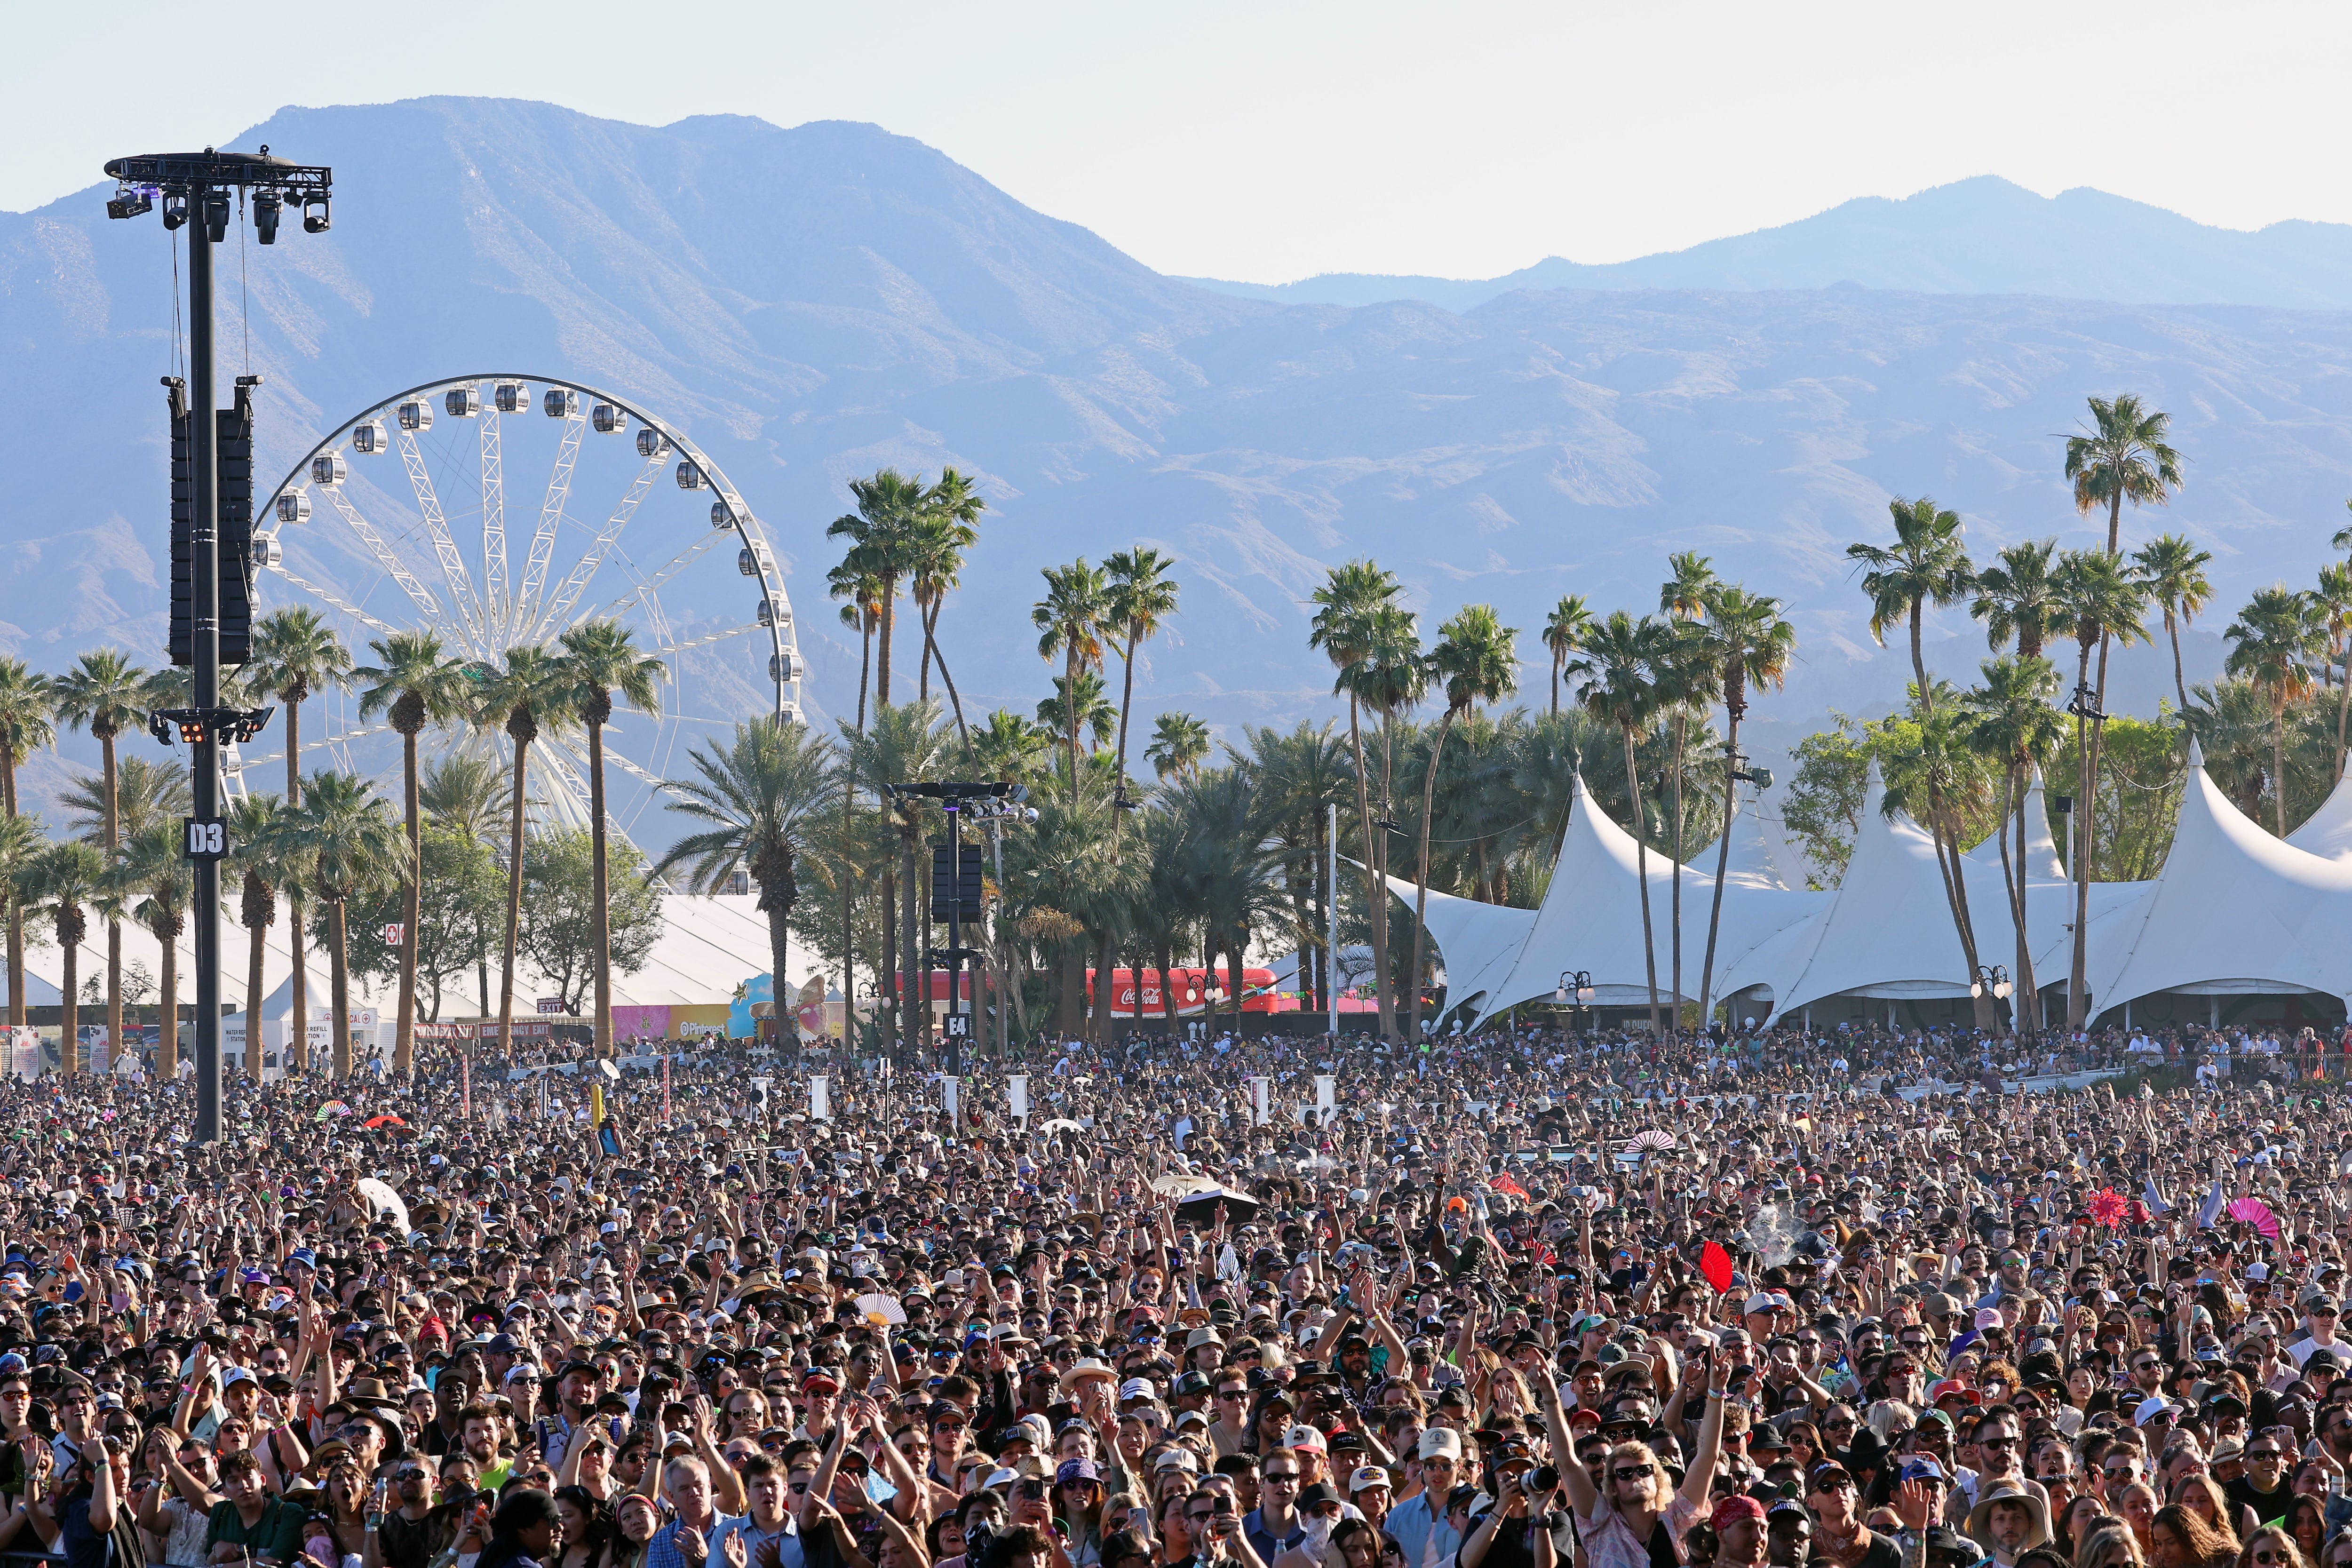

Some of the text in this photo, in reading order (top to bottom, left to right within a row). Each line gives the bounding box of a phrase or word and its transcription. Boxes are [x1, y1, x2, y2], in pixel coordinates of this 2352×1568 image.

[191, 823, 222, 852] D3
[539, 1003, 561, 1012] EXIT
[482, 1025, 549, 1036] EMEENCY EXIT
[690, 1023, 725, 1035] Pinterest
[949, 1018, 966, 1035] E4
[1310, 1329, 1318, 1337] LA
[652, 1372, 661, 1381] LA
